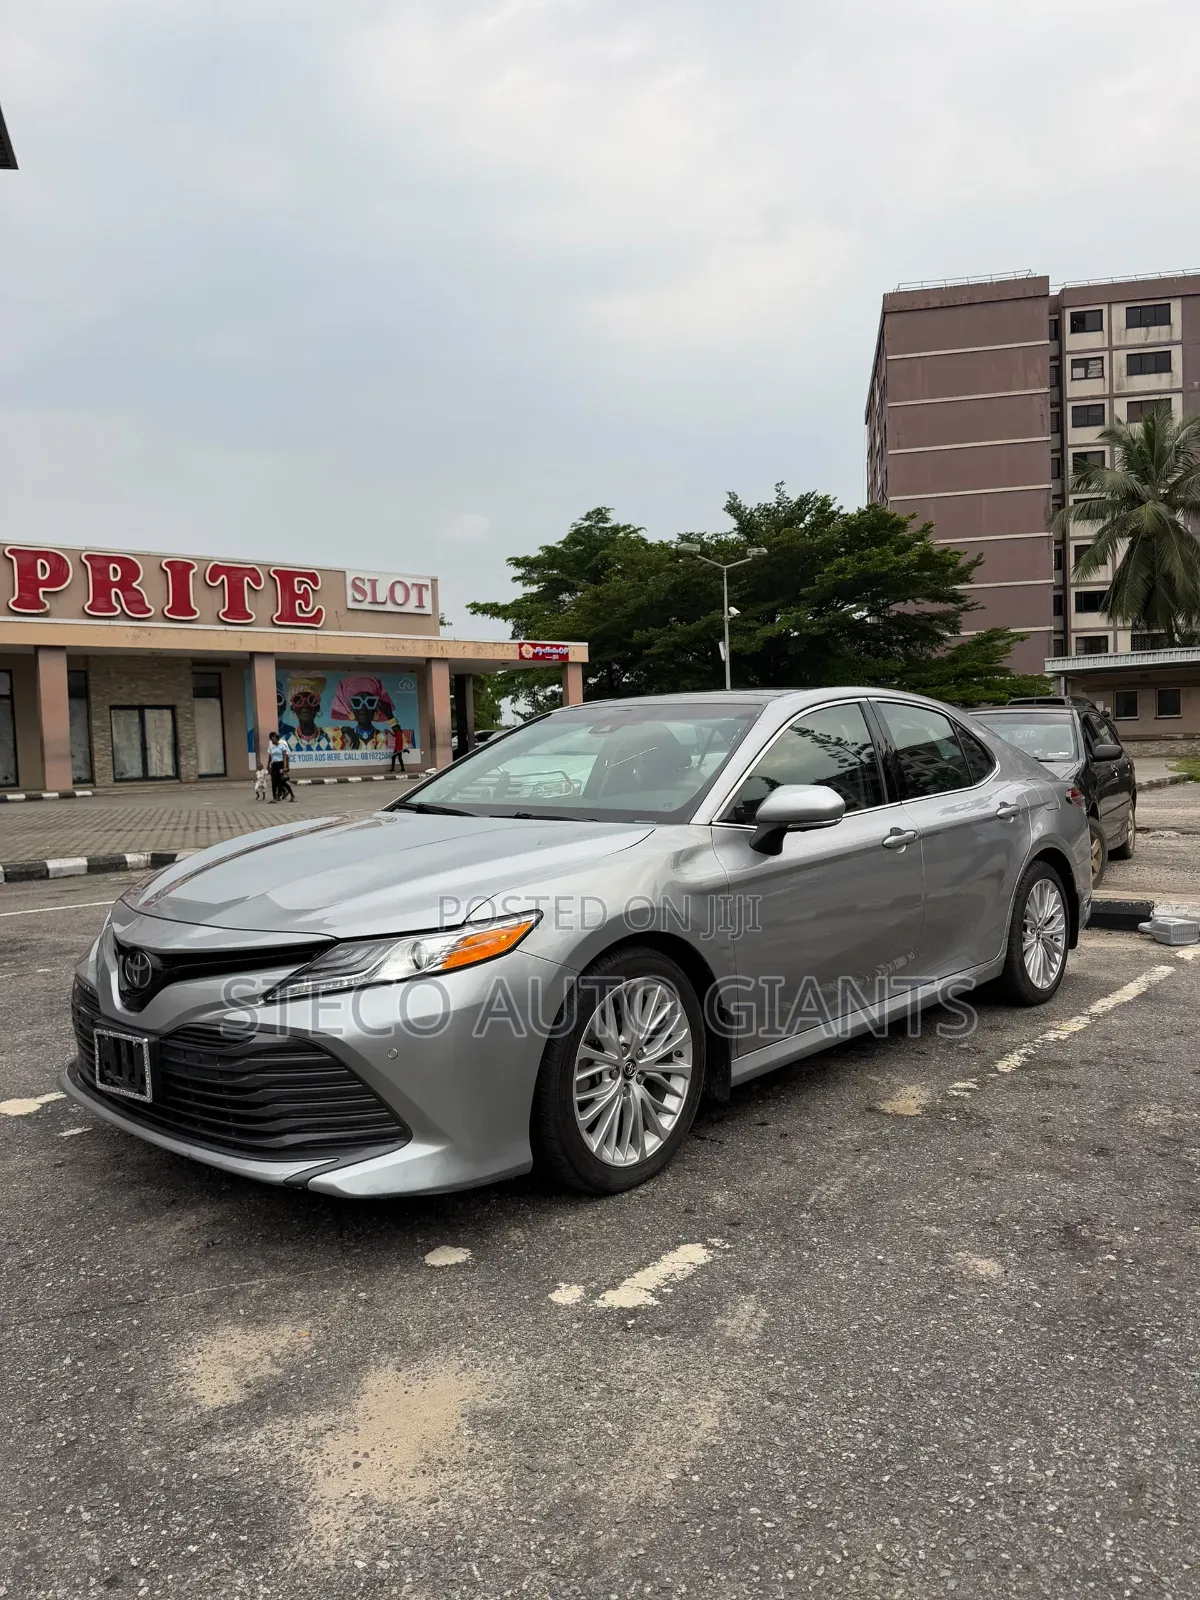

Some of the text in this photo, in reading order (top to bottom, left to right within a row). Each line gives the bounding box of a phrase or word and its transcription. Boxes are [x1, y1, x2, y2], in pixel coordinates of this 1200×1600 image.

[4, 545, 325, 628] PRITE
[351, 576, 429, 609] SLOT
[297, 753, 314, 762] YOUR
[314, 753, 327, 762] ADS
[326, 752, 344, 762] HERE,
[344, 751, 360, 761] CALL:
